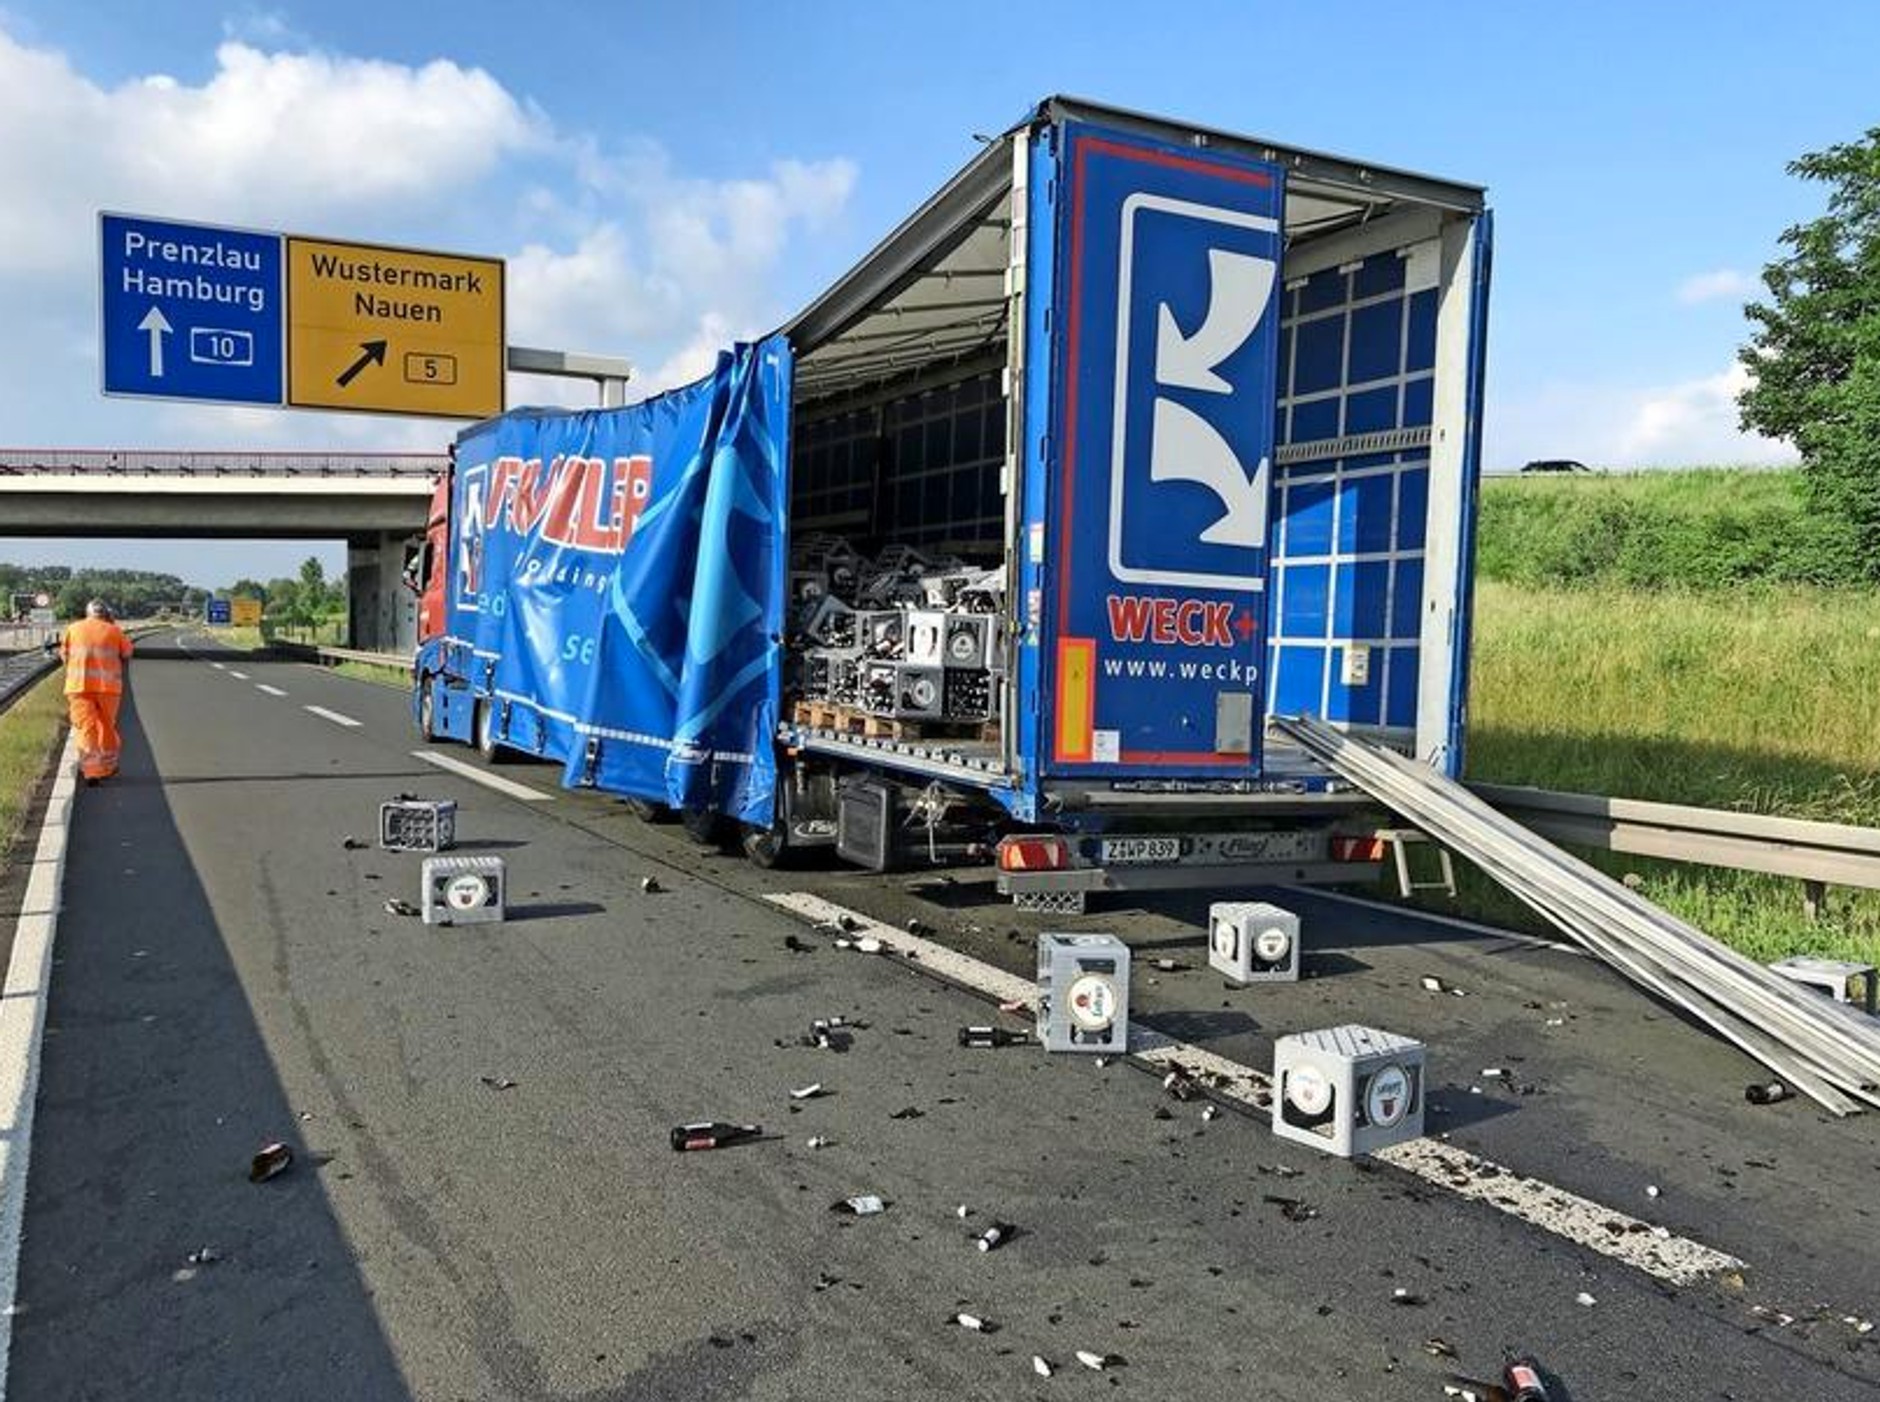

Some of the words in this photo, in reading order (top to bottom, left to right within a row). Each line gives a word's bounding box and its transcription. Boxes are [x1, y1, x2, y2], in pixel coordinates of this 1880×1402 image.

[125, 231, 261, 271] Prenzlau
[311, 254, 482, 294] Wustermark
[123, 266, 265, 312] Hamburg
[354, 292, 442, 323] Nauen
[210, 336, 235, 358] 10
[424, 359, 438, 379] 5
[1104, 658, 1258, 686] www.weckp
[1149, 841, 1176, 858] 839
